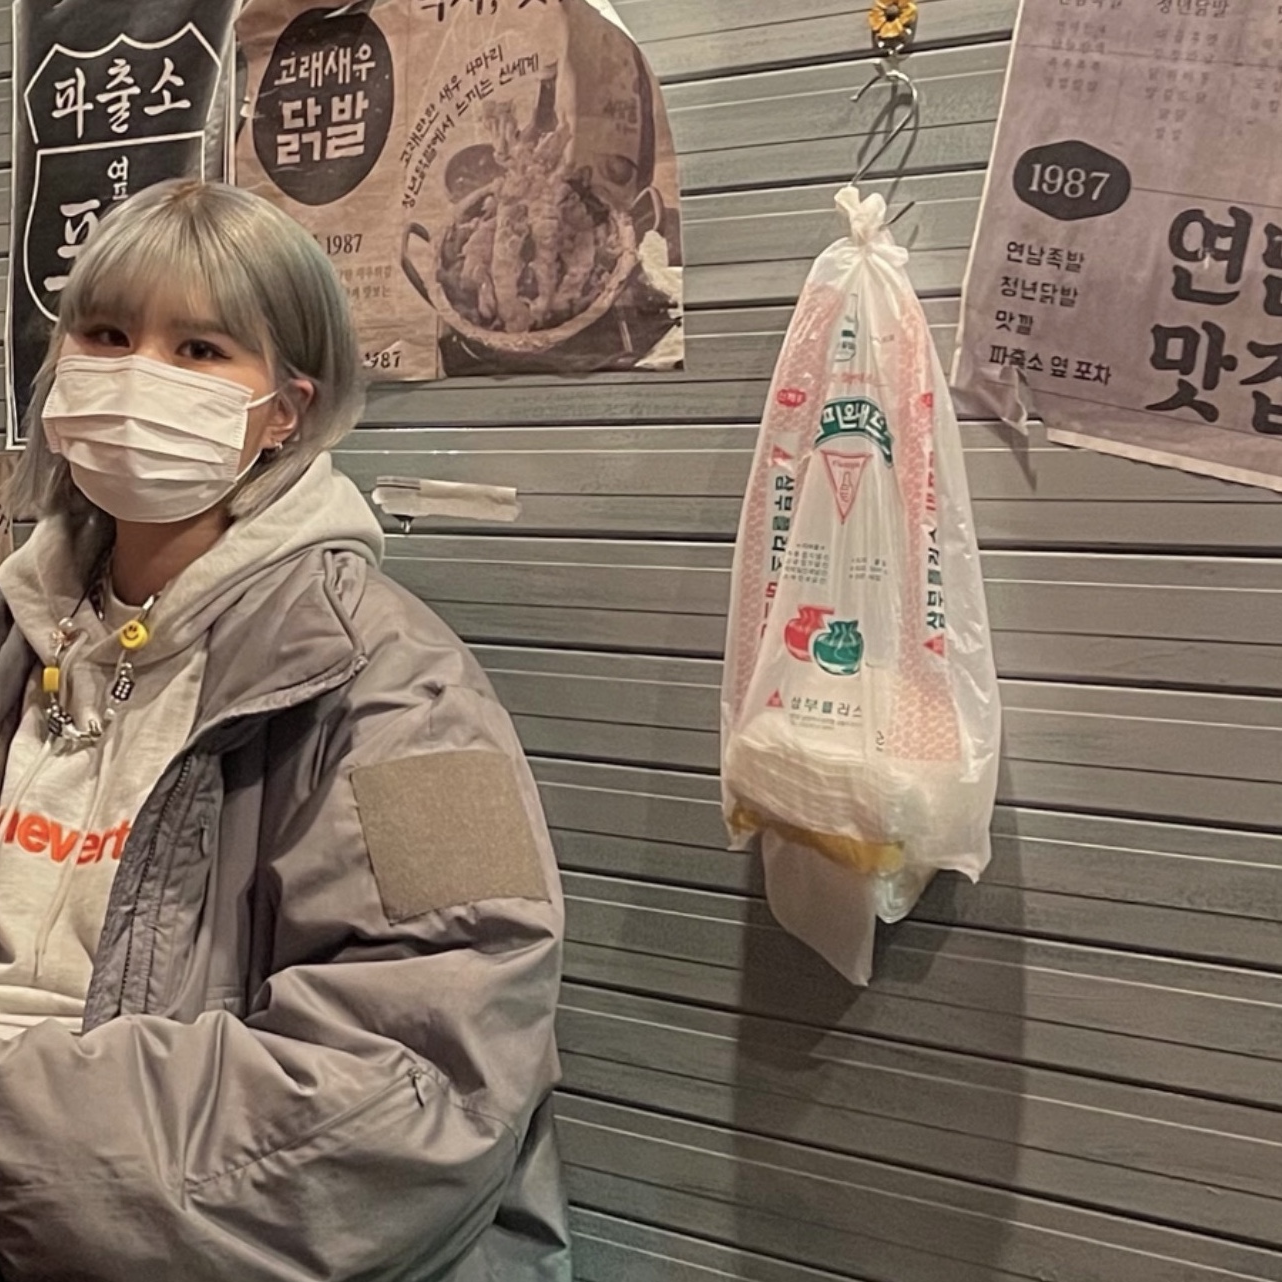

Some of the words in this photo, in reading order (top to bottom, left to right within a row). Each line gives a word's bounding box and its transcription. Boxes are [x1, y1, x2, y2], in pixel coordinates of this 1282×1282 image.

[274, 43, 376, 89] 고래새우
[50, 58, 192, 139] 파출소
[439, 75, 463, 103] 새우
[455, 79, 495, 117] 느끼는
[499, 53, 539, 87] 신세계
[275, 91, 370, 166] 닭발
[1028, 162, 1111, 202] 1987
[326, 232, 363, 255] 1987
[1006, 241, 1086, 273] 연남족발
[1000, 275, 1079, 308] 청년닭발
[1050, 355, 1068, 378] 옆
[1073, 360, 1112, 386] 포차
